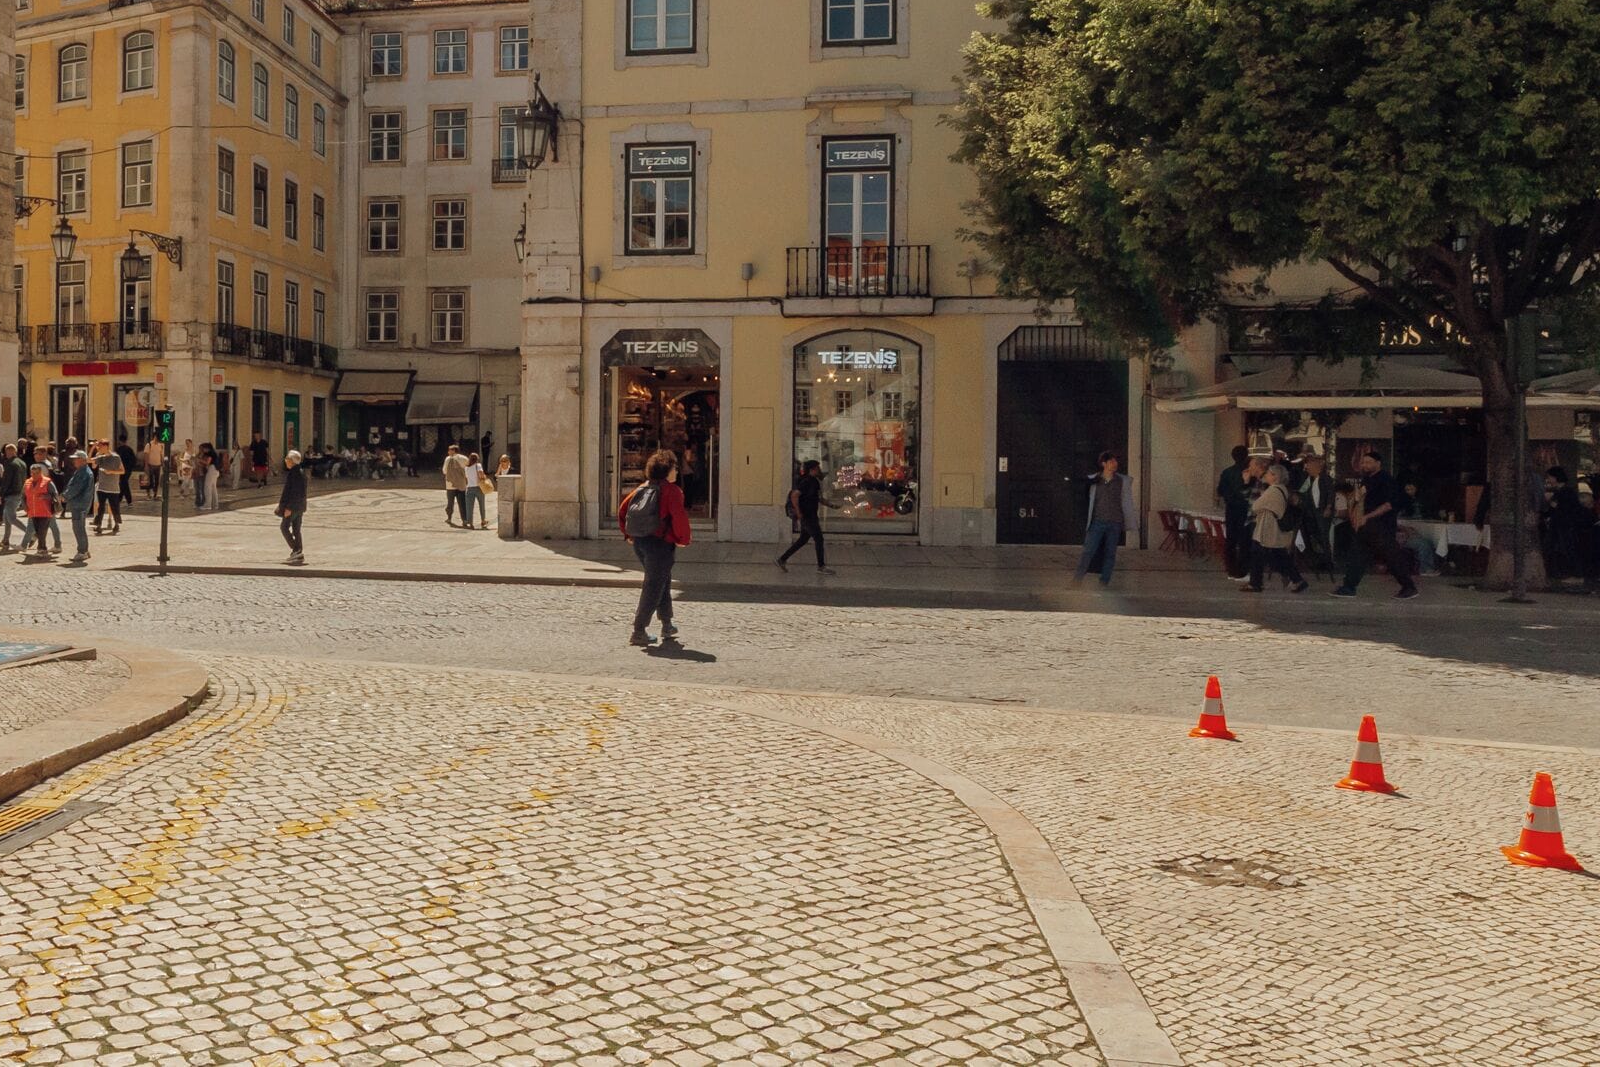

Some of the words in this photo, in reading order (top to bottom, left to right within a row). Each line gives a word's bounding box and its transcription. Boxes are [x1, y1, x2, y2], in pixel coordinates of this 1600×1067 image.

[638, 155, 688, 167] TEZENIS
[834, 148, 886, 161] TEZENIS
[622, 337, 699, 354] TEZENIS
[817, 347, 898, 365] TEZENIS
[163, 413, 171, 423] 12
